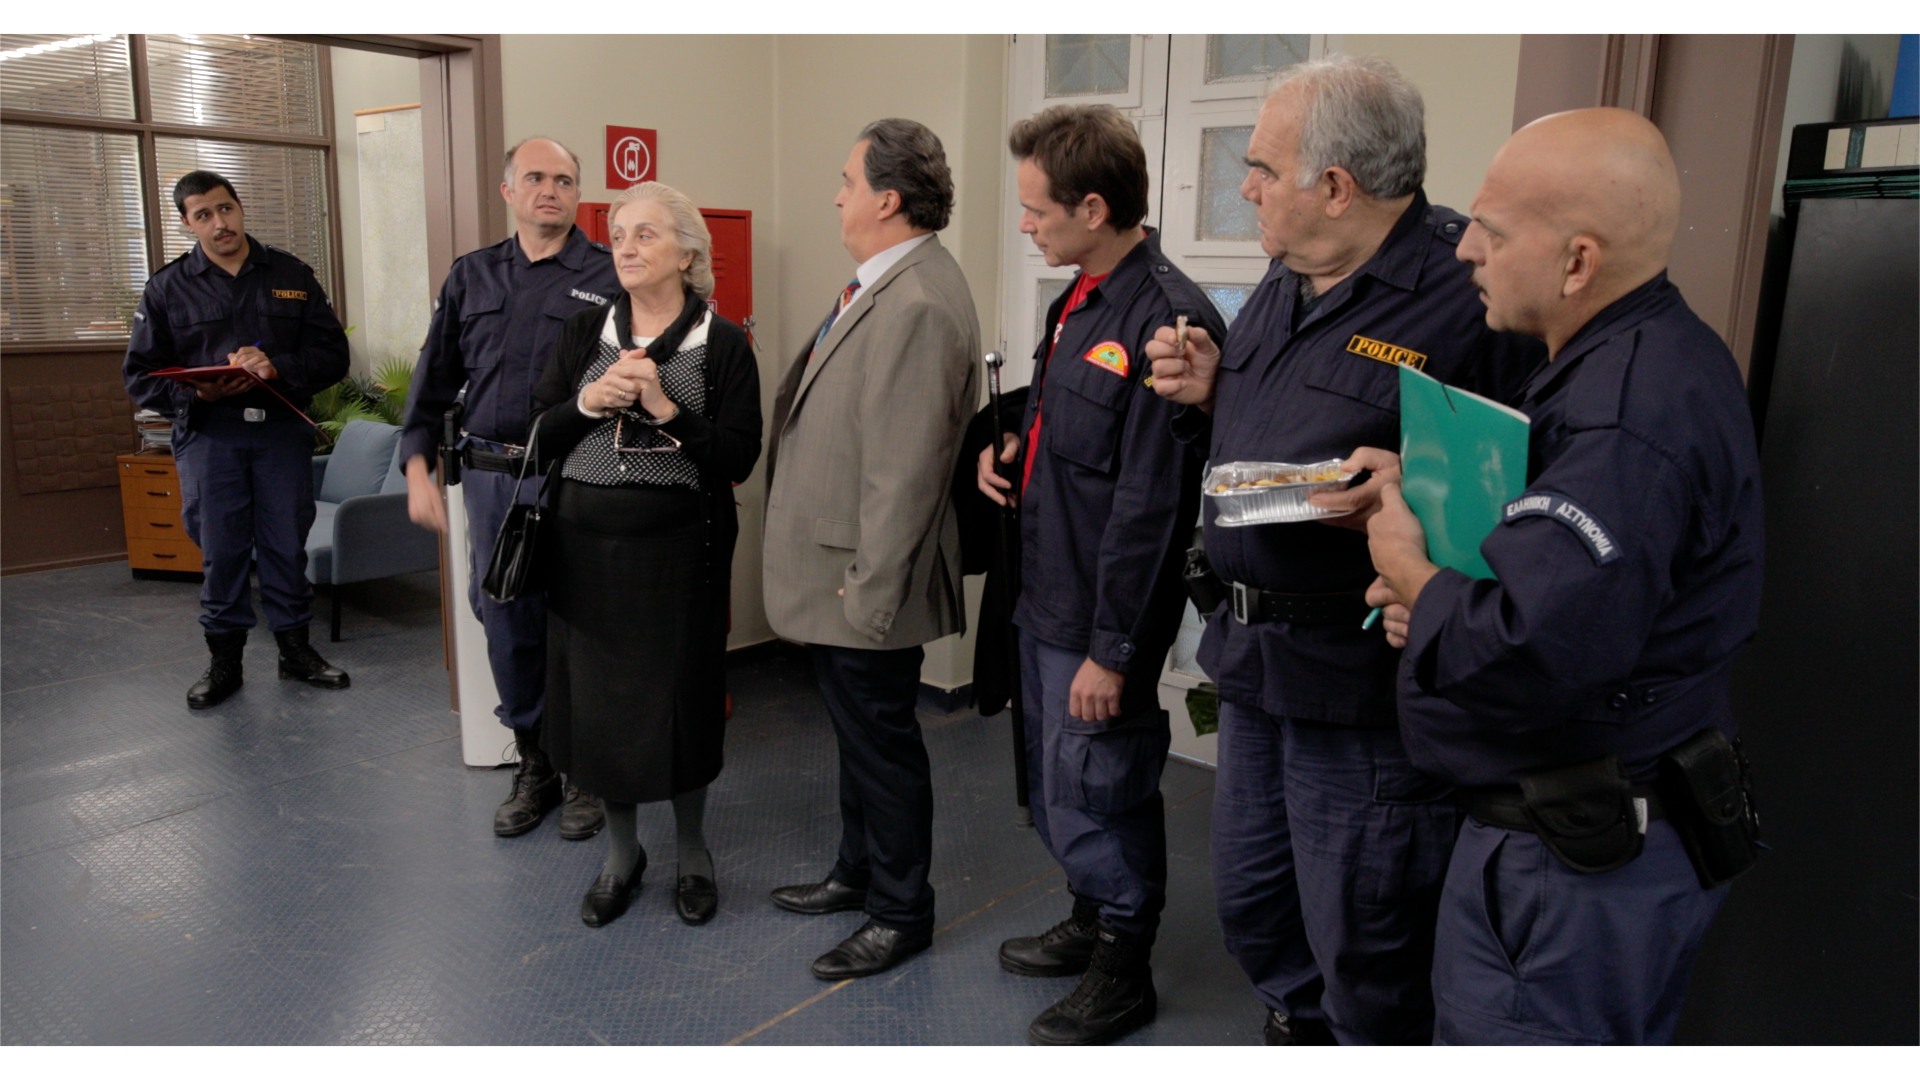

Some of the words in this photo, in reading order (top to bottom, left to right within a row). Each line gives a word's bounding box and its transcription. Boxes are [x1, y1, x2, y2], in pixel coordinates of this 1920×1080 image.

[275, 290, 305, 299] POLICE
[571, 288, 607, 305] POLICE
[1355, 339, 1419, 368] POLICE
[1506, 496, 1551, 516] ΕΛΛΗΝΙΚΗ
[1555, 502, 1613, 557] ΑΣΤΥΝΟΜΙΑ
